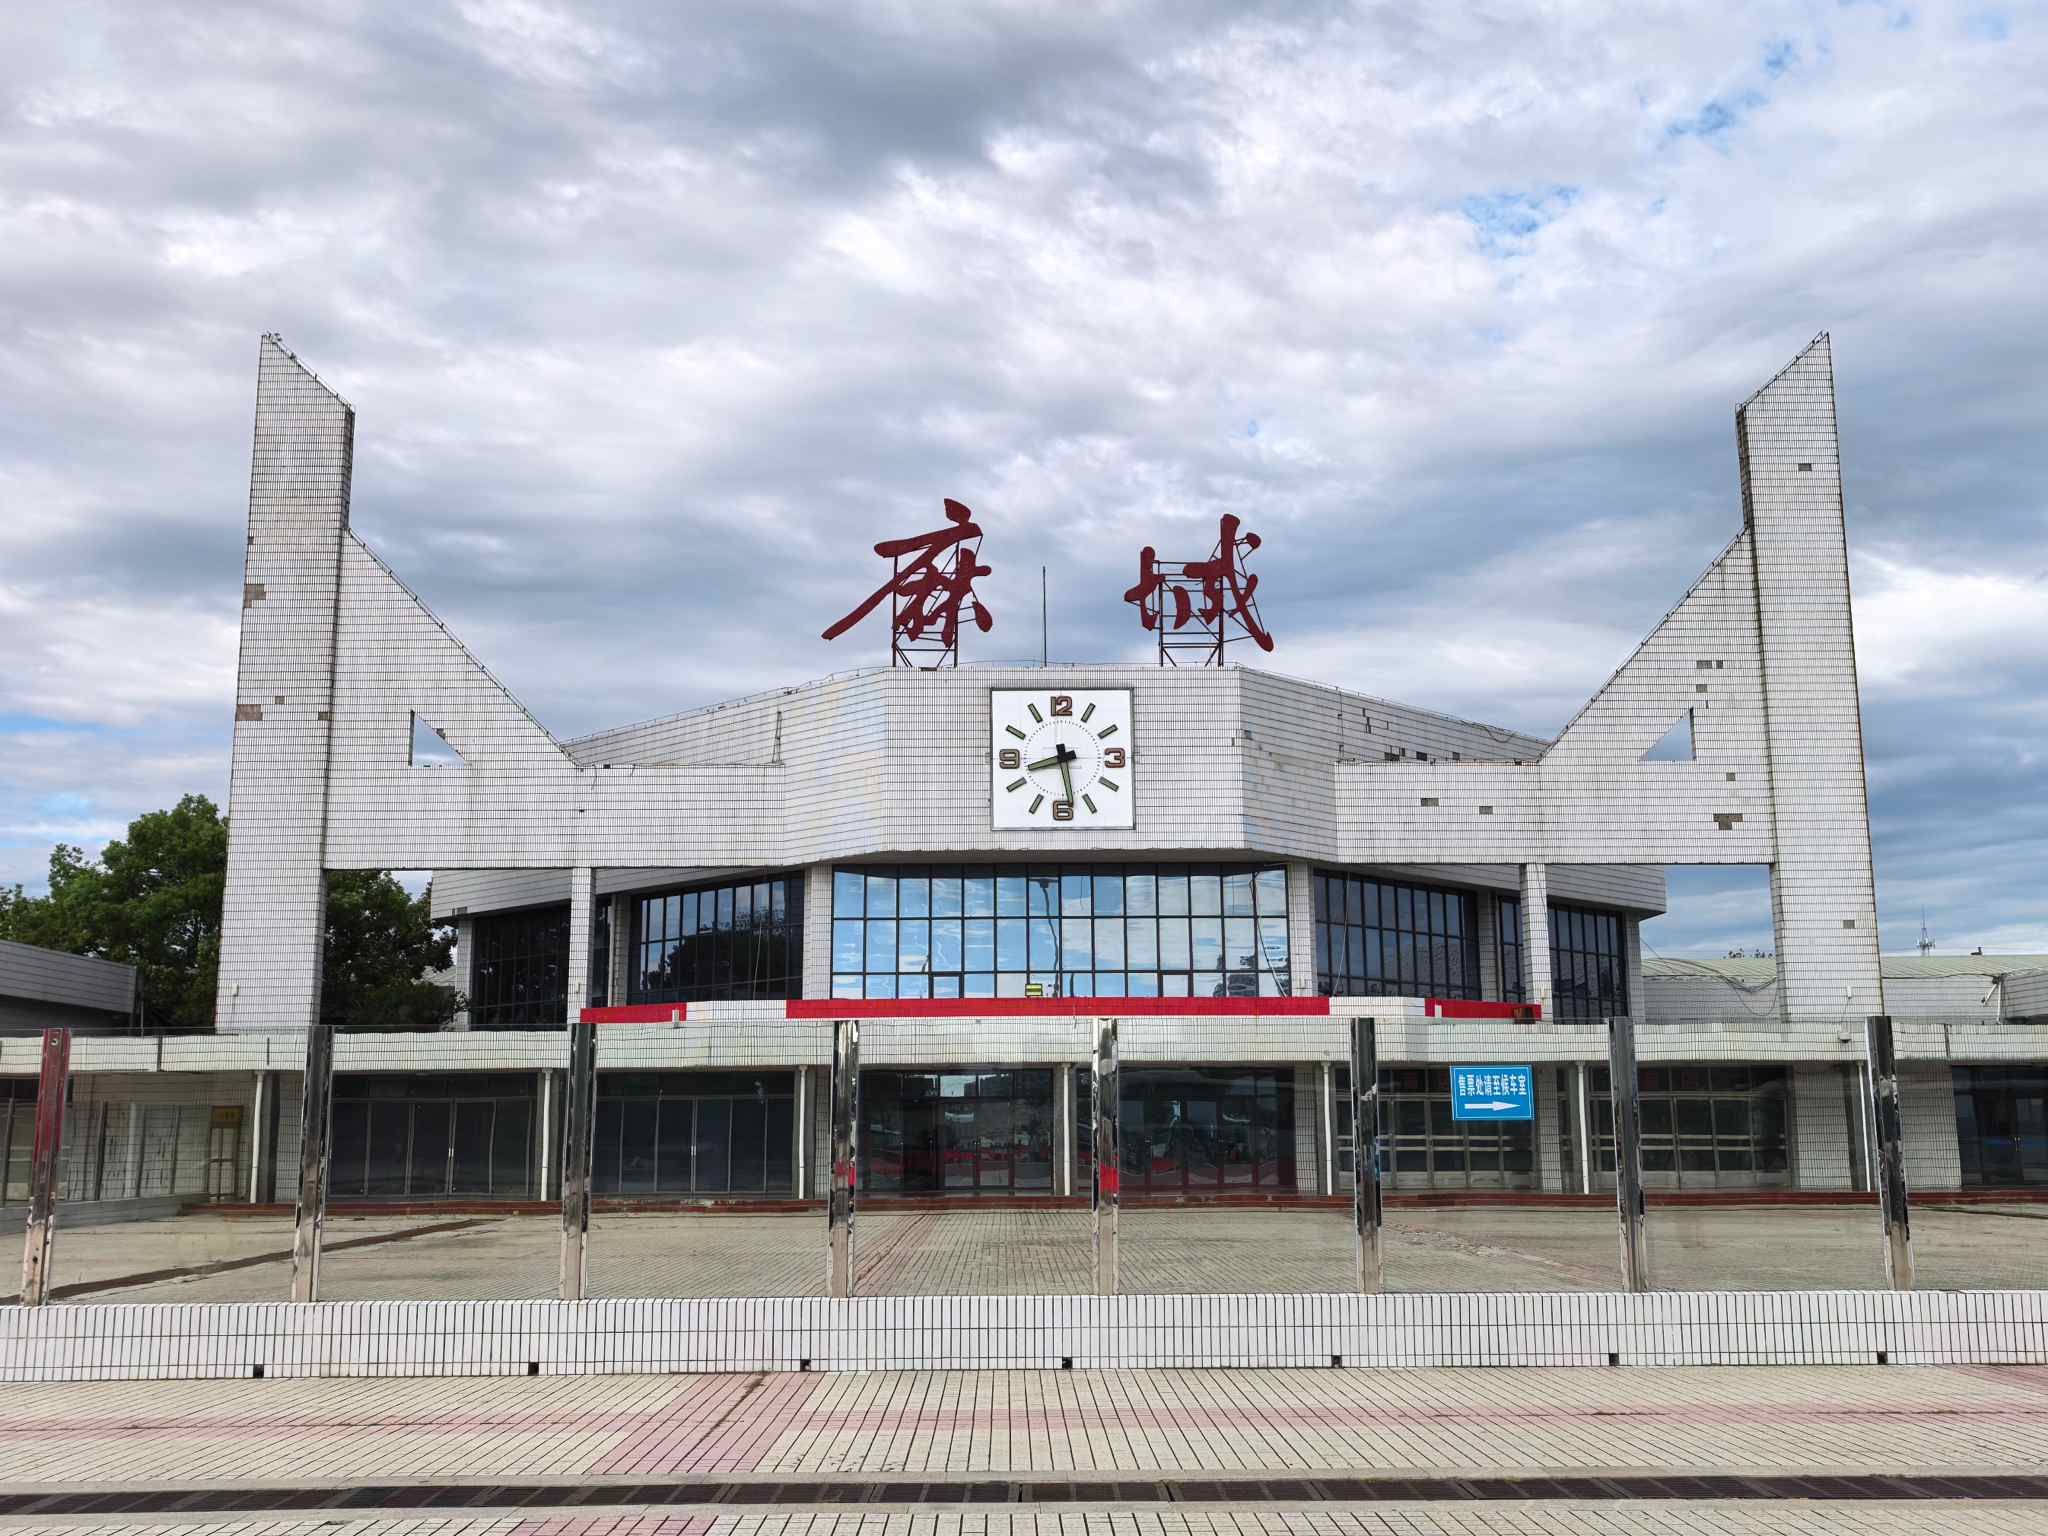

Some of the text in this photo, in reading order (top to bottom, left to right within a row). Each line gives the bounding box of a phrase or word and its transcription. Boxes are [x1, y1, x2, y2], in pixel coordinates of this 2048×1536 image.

[821, 498, 1274, 652] 麻城
[1050, 695, 1073, 717] 12
[999, 748, 1021, 769] 9
[1104, 747, 1126, 769] 3
[1052, 800, 1074, 821] 6
[1458, 1073, 1527, 1096] 售票处请至候车室
